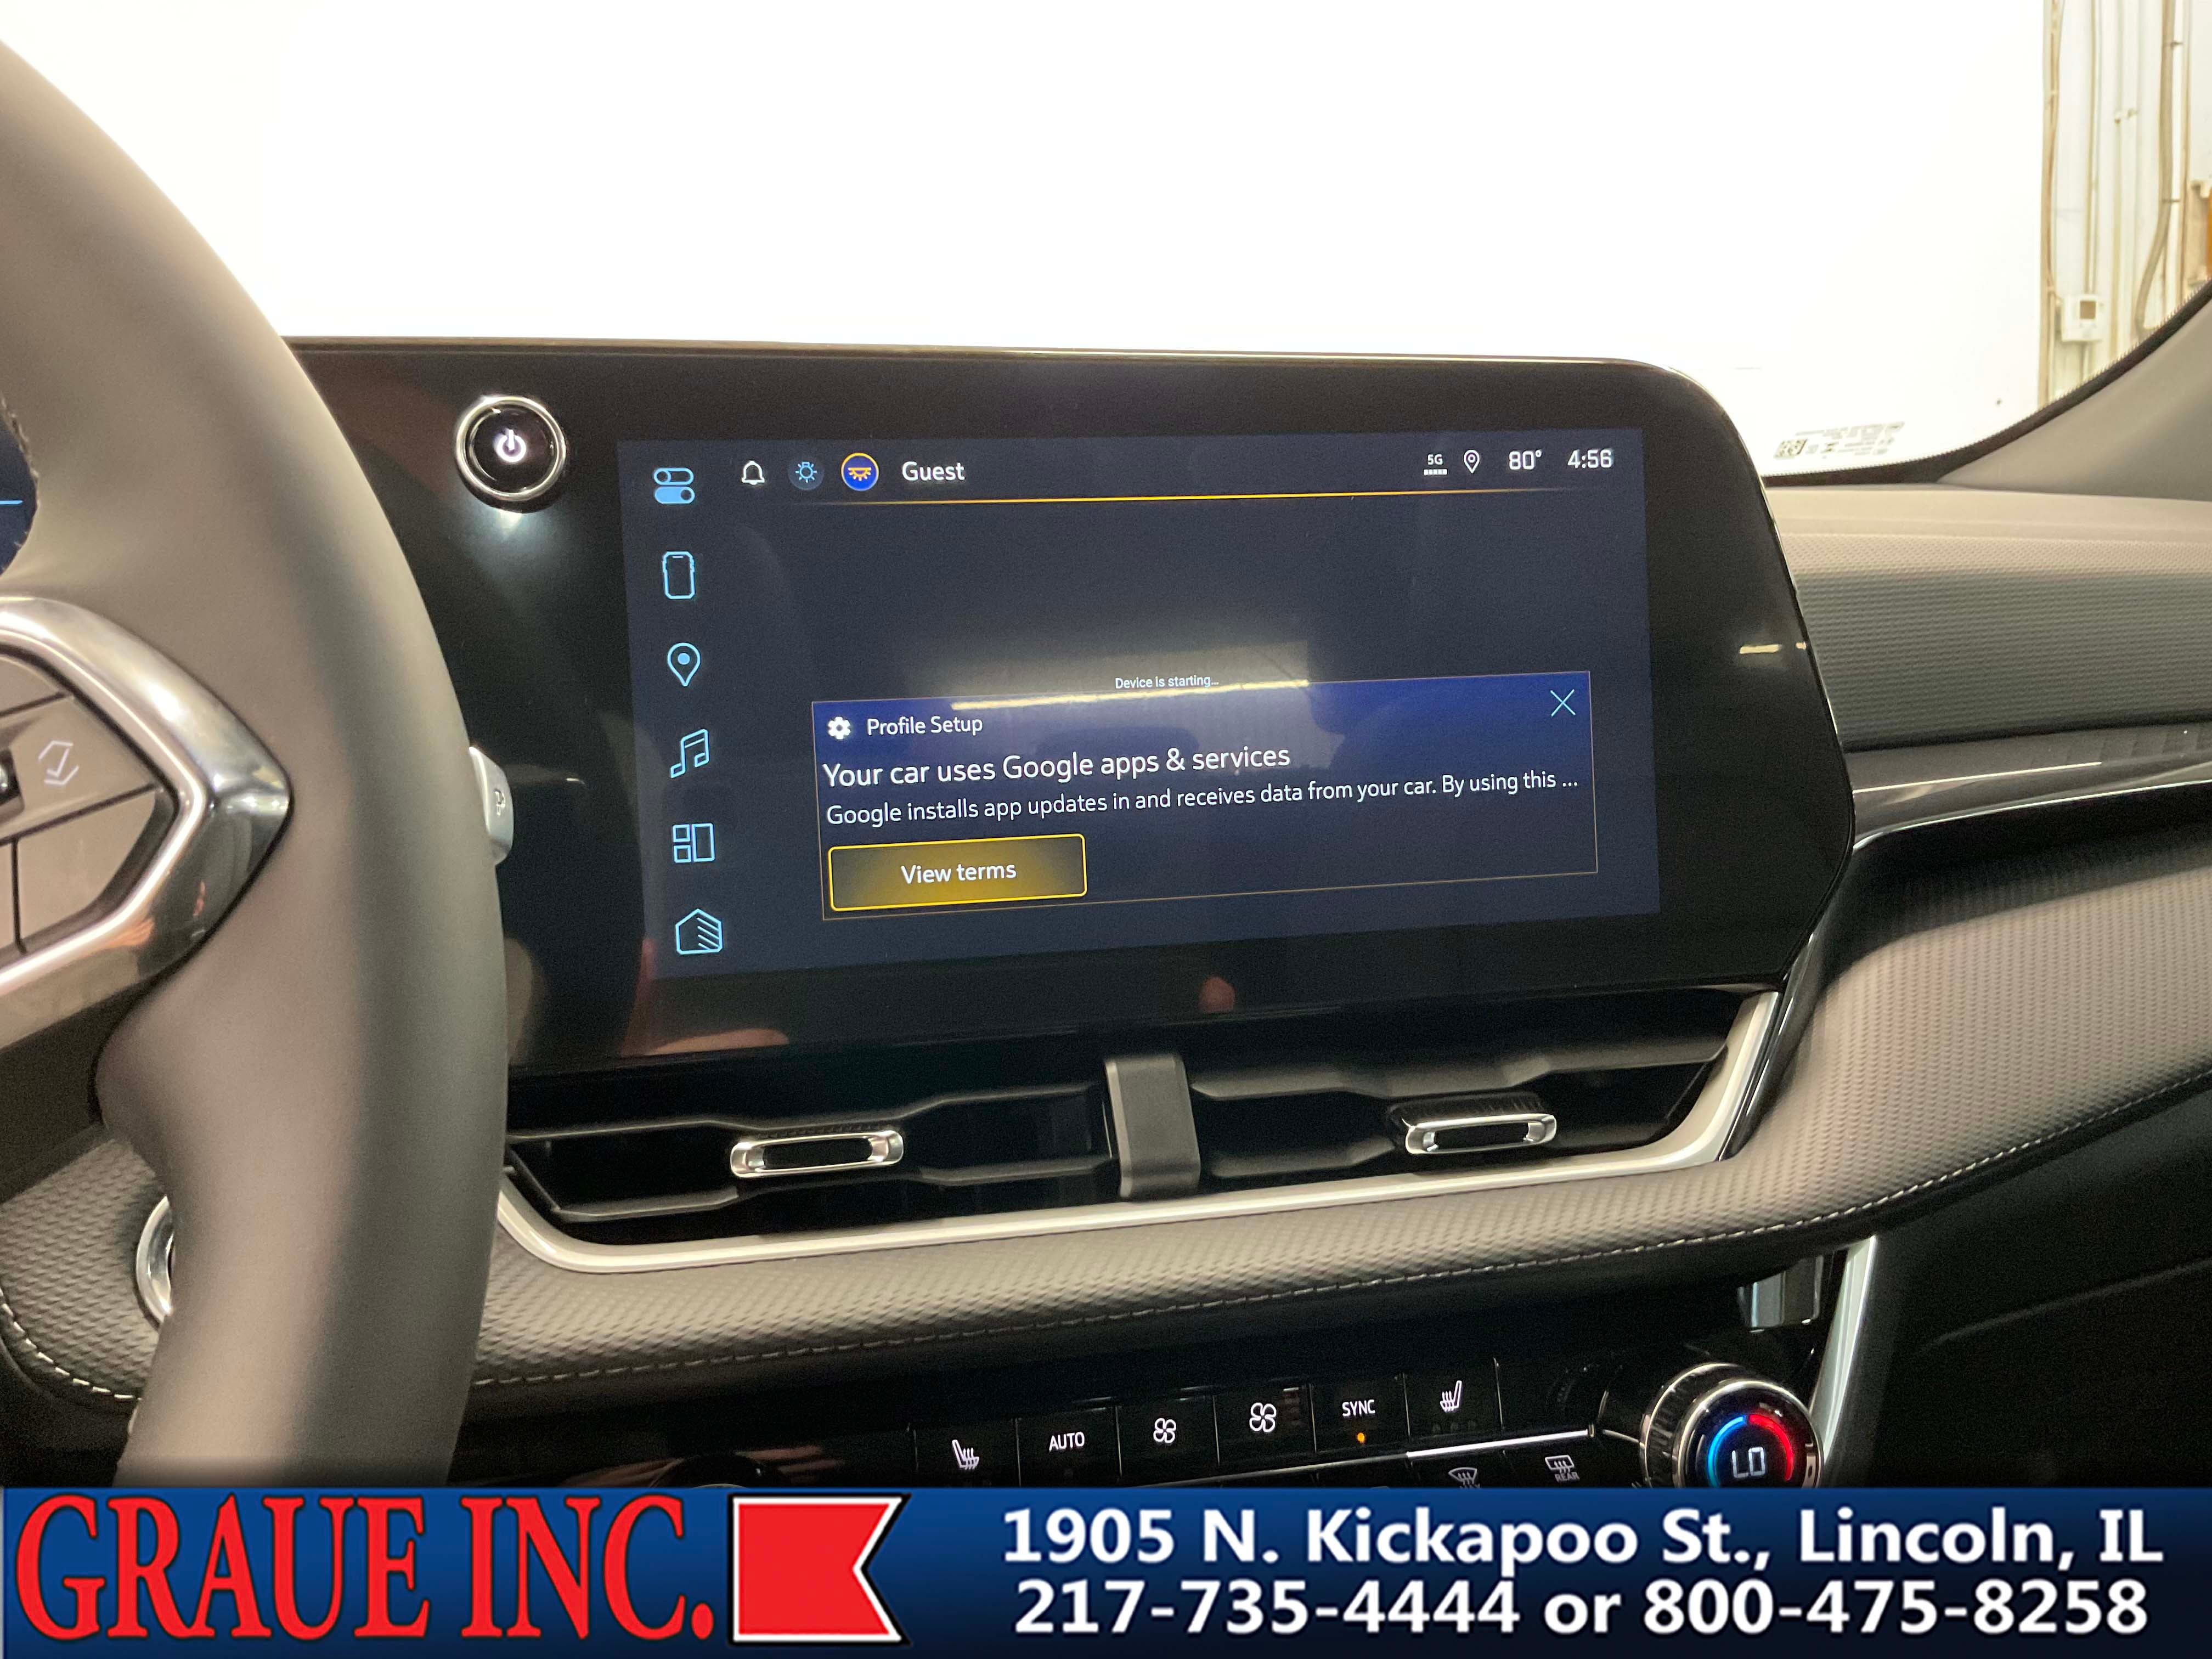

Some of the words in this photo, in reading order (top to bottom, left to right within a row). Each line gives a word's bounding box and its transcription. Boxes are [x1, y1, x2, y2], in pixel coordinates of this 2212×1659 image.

[1427, 454, 1443, 465] 5G
[1508, 449, 1543, 471] 80°
[1567, 448, 1613, 469] 4:56
[901, 460, 966, 482] Guest
[1115, 676, 1153, 689] Device
[1155, 676, 1165, 687] is
[867, 715, 927, 736] Profile
[930, 715, 984, 735] Setup
[822, 763, 884, 787] Your
[890, 765, 930, 785] car
[937, 763, 996, 783] uses
[1002, 751, 1094, 783] Google
[1100, 755, 1160, 781] apps
[1165, 747, 1186, 772] &
[1192, 745, 1291, 770] services
[826, 801, 902, 828] Google
[907, 797, 979, 821] installs
[984, 801, 1022, 822] app
[1028, 792, 1108, 820] updates
[1113, 792, 1130, 810] in
[1135, 787, 1171, 810] and
[1177, 787, 1256, 807] receives
[1260, 782, 1303, 803] data
[1307, 780, 1353, 800] from
[1356, 782, 1400, 803] your
[1403, 779, 1437, 795] car.
[1442, 774, 1465, 798] By
[1469, 773, 1519, 795] using
[1522, 769, 1557, 789] this
[900, 864, 952, 884] View
[956, 863, 1017, 882] terms
[1341, 1398, 1376, 1418] SYNC
[1048, 1431, 1086, 1452] AUTO
[1554, 1471, 1581, 1482] REAR
